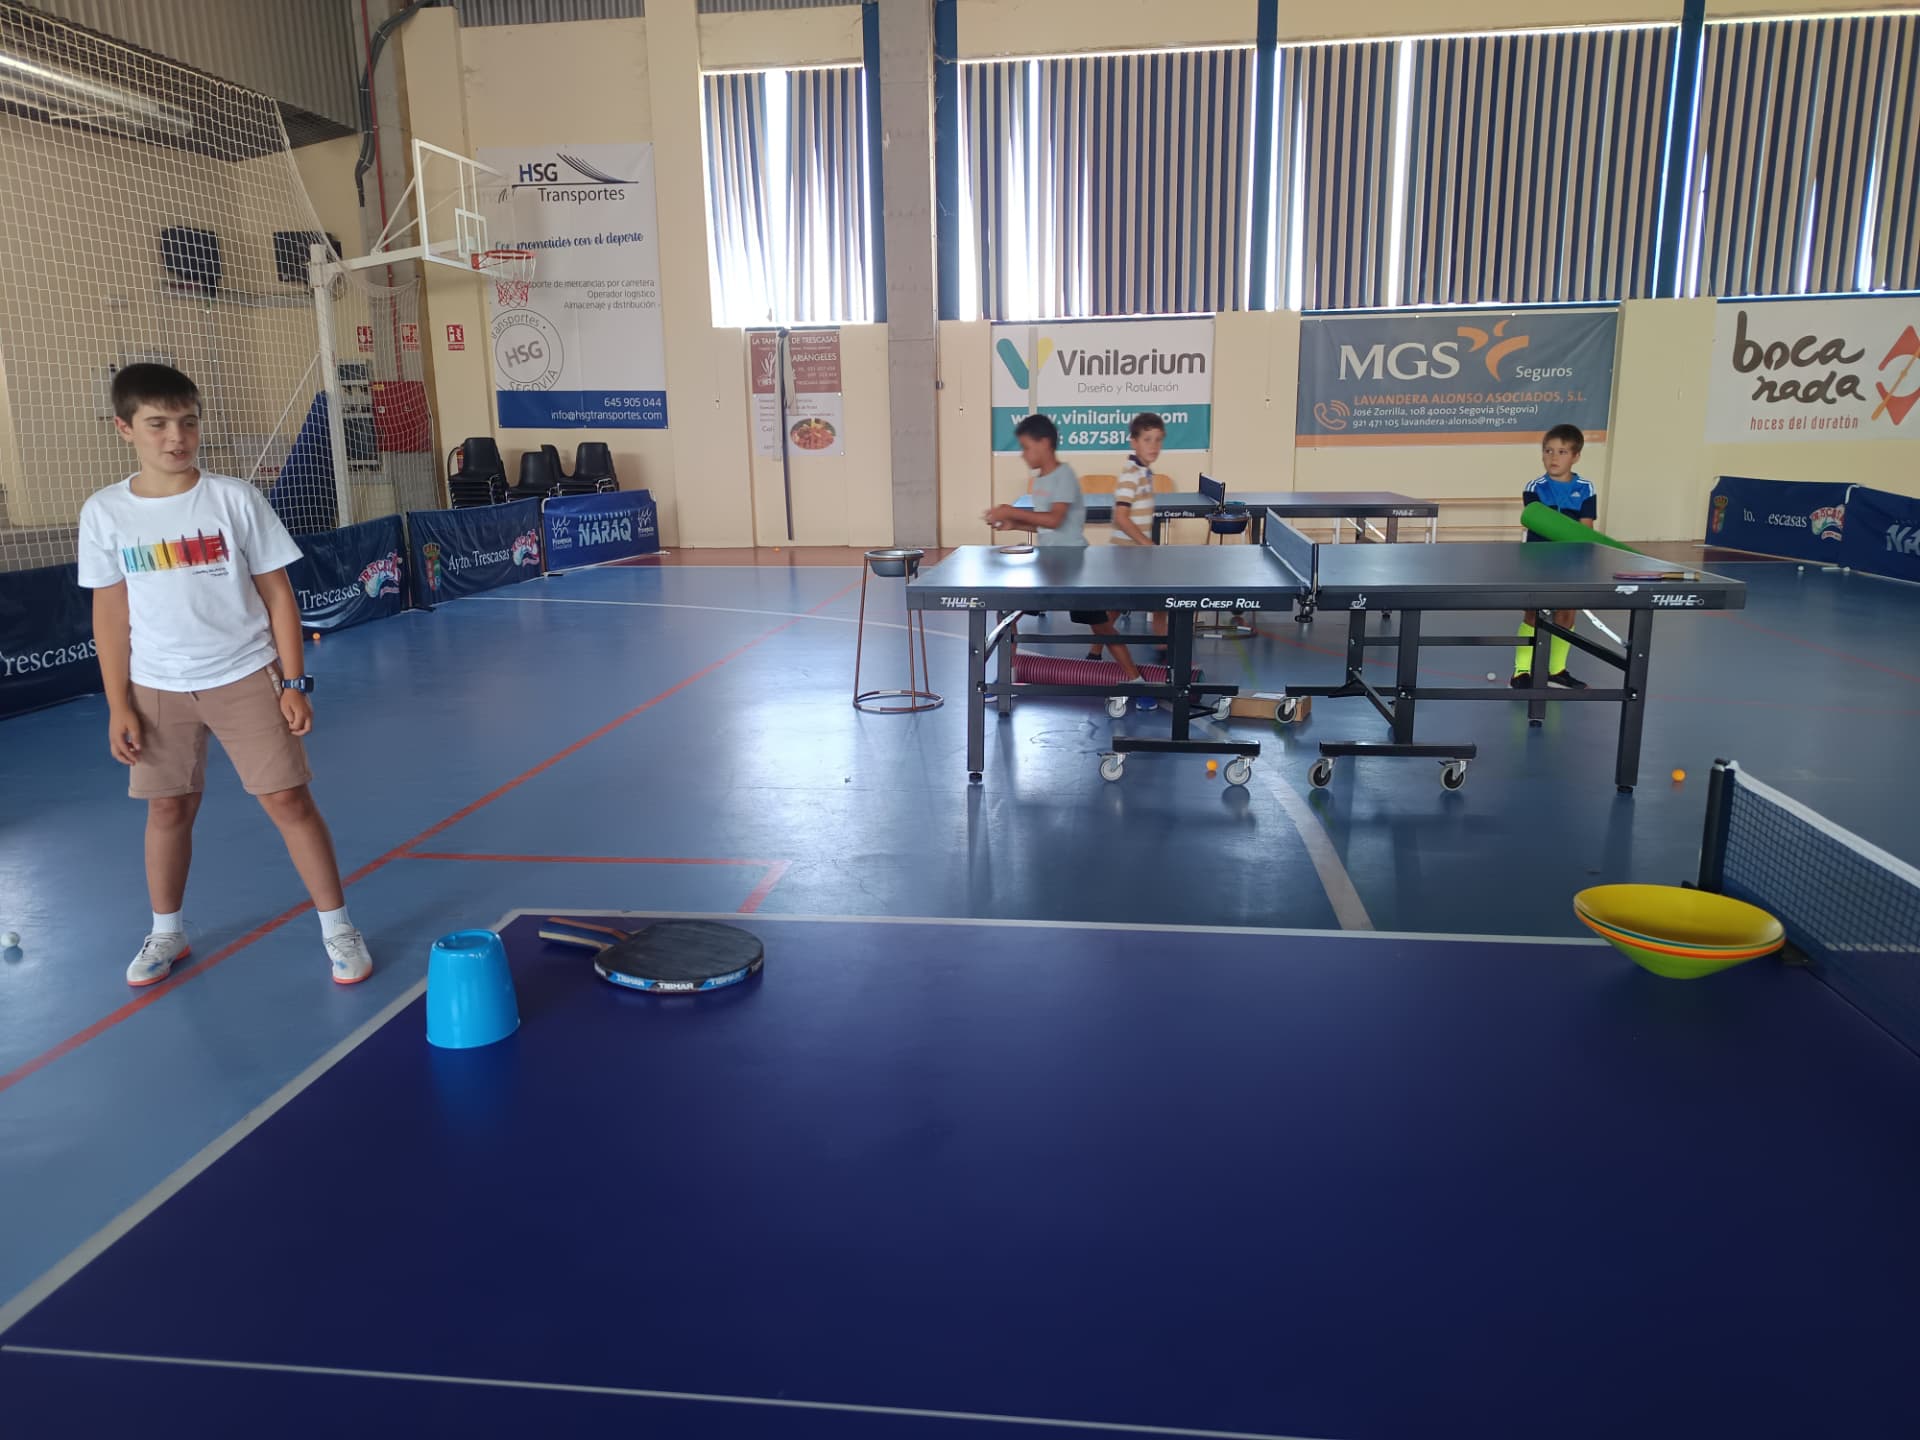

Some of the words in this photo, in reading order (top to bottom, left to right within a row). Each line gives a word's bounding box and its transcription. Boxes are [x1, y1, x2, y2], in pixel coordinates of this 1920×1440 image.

[519, 163, 558, 182] HSG
[537, 187, 625, 205] Transportes
[587, 289, 623, 299] Operador
[491, 313, 540, 339] ransportes
[1733, 310, 1866, 374] boca
[505, 340, 543, 368] HSG
[1057, 348, 1206, 376] Vinilarium
[1337, 341, 1460, 381] MGS
[1515, 365, 1573, 382] Seguros
[1077, 382, 1114, 393] Diseño
[1116, 384, 1121, 394] y
[1125, 381, 1179, 393] Rotulación
[604, 397, 621, 407] 645
[623, 397, 641, 407] 905
[643, 397, 661, 407] 044
[1354, 394, 1428, 406] LAVANDERA
[1431, 393, 1483, 405] ALONSO
[551, 409, 663, 422] info@hsgtransportes.com
[1353, 407, 1372, 417] José
[1374, 406, 1408, 417] Zorrilla,
[1410, 406, 1425, 415] 108
[1459, 405, 1494, 417] Segovia
[1496, 404, 1538, 416] (Segovia)
[1353, 420, 1366, 428] 921
[1750, 416, 1785, 431] hoces
[1789, 415, 1807, 430] del
[1811, 414, 1859, 430] duratón
[1768, 513, 1808, 528] escasas
[578, 517, 632, 547] NARAQ
[448, 554, 472, 576] Ayto.
[473, 548, 510, 567] Trescasas
[298, 582, 361, 610] Trescasas
[0, 638, 98, 677] rescasas
